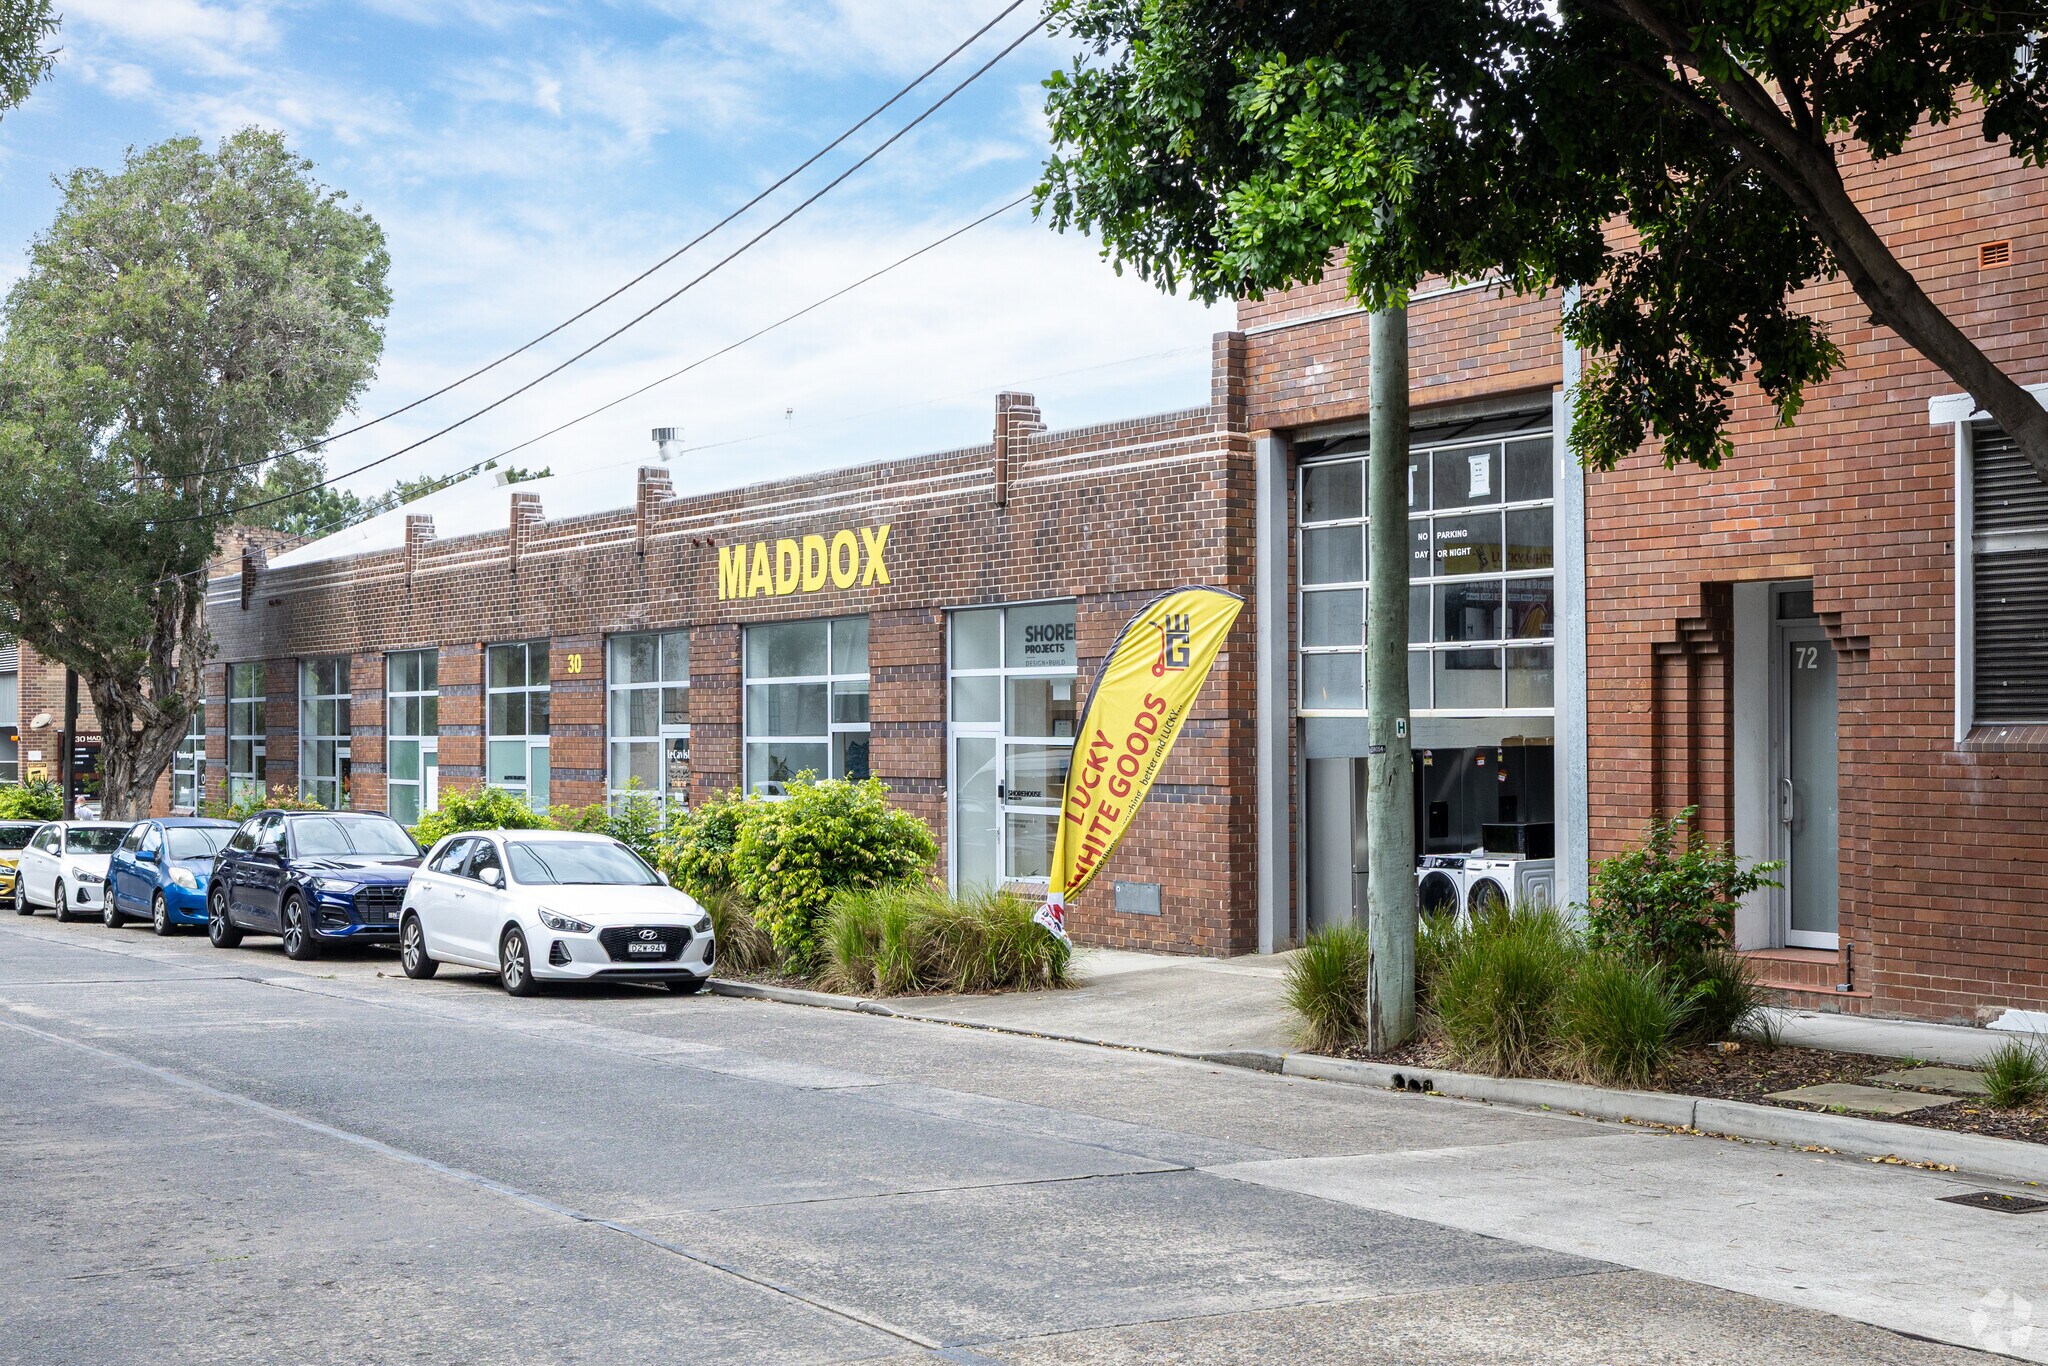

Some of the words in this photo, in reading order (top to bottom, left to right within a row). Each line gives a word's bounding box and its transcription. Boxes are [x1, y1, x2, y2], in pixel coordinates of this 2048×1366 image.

[1418, 532, 1428, 541] NO
[1437, 530, 1468, 539] PARKING
[1415, 550, 1428, 559] DAY
[1437, 550, 1448, 558] OR
[1449, 547, 1471, 557] NIGHT
[1491, 551, 1524, 563] LUKY
[719, 525, 891, 600] MADDOX
[1025, 623, 1076, 643] SHORE
[1025, 643, 1065, 654] PROJECTS
[567, 653, 582, 674] 30
[1796, 646, 1818, 669] 72
[1397, 721, 1406, 735] H
[74, 735, 85, 743] 30
[1139, 757, 1158, 786] better
[1155, 738, 1166, 758] and
[1161, 704, 1183, 739] LUCKY...
[1065, 729, 1114, 826] LUCKY
[1008, 790, 1042, 798] SHOREHOUSE
[1066, 799, 1121, 889] WHITE
[1108, 692, 1166, 798] GOODS
